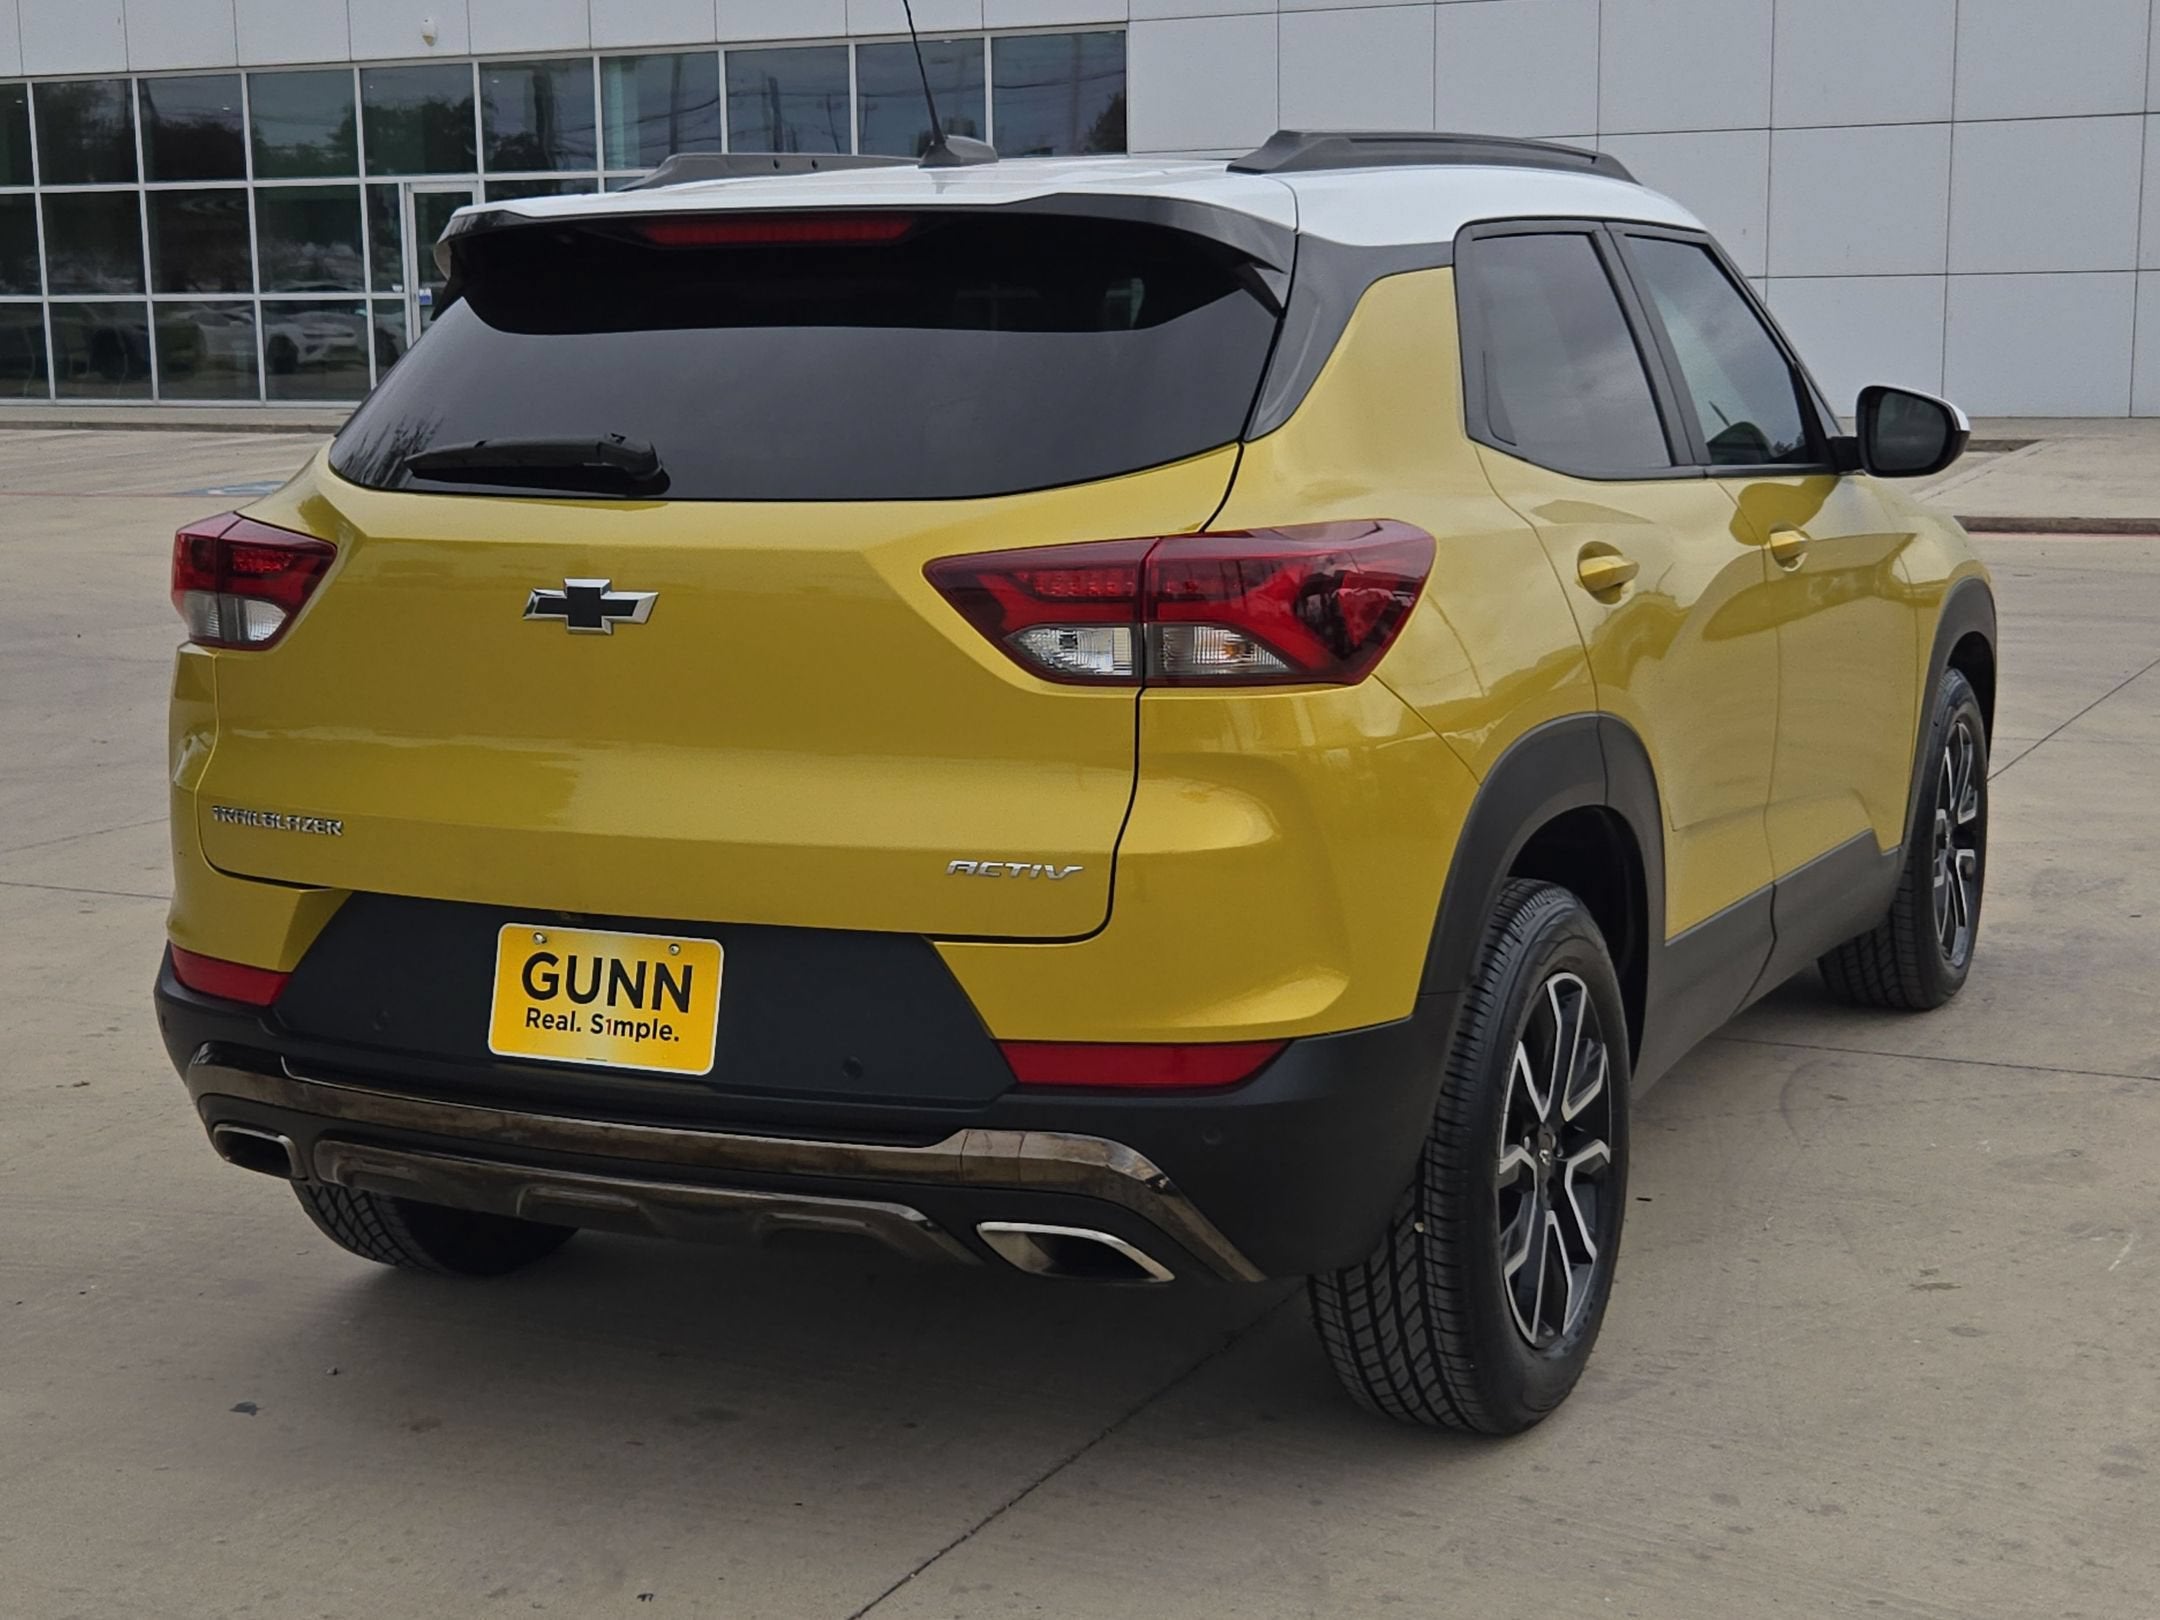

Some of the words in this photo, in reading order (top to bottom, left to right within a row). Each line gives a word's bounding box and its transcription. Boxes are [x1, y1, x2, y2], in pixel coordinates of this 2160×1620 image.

[946, 860, 1084, 879] ACTIV
[522, 952, 693, 1014] GUNN
[525, 1007, 582, 1032] Real.
